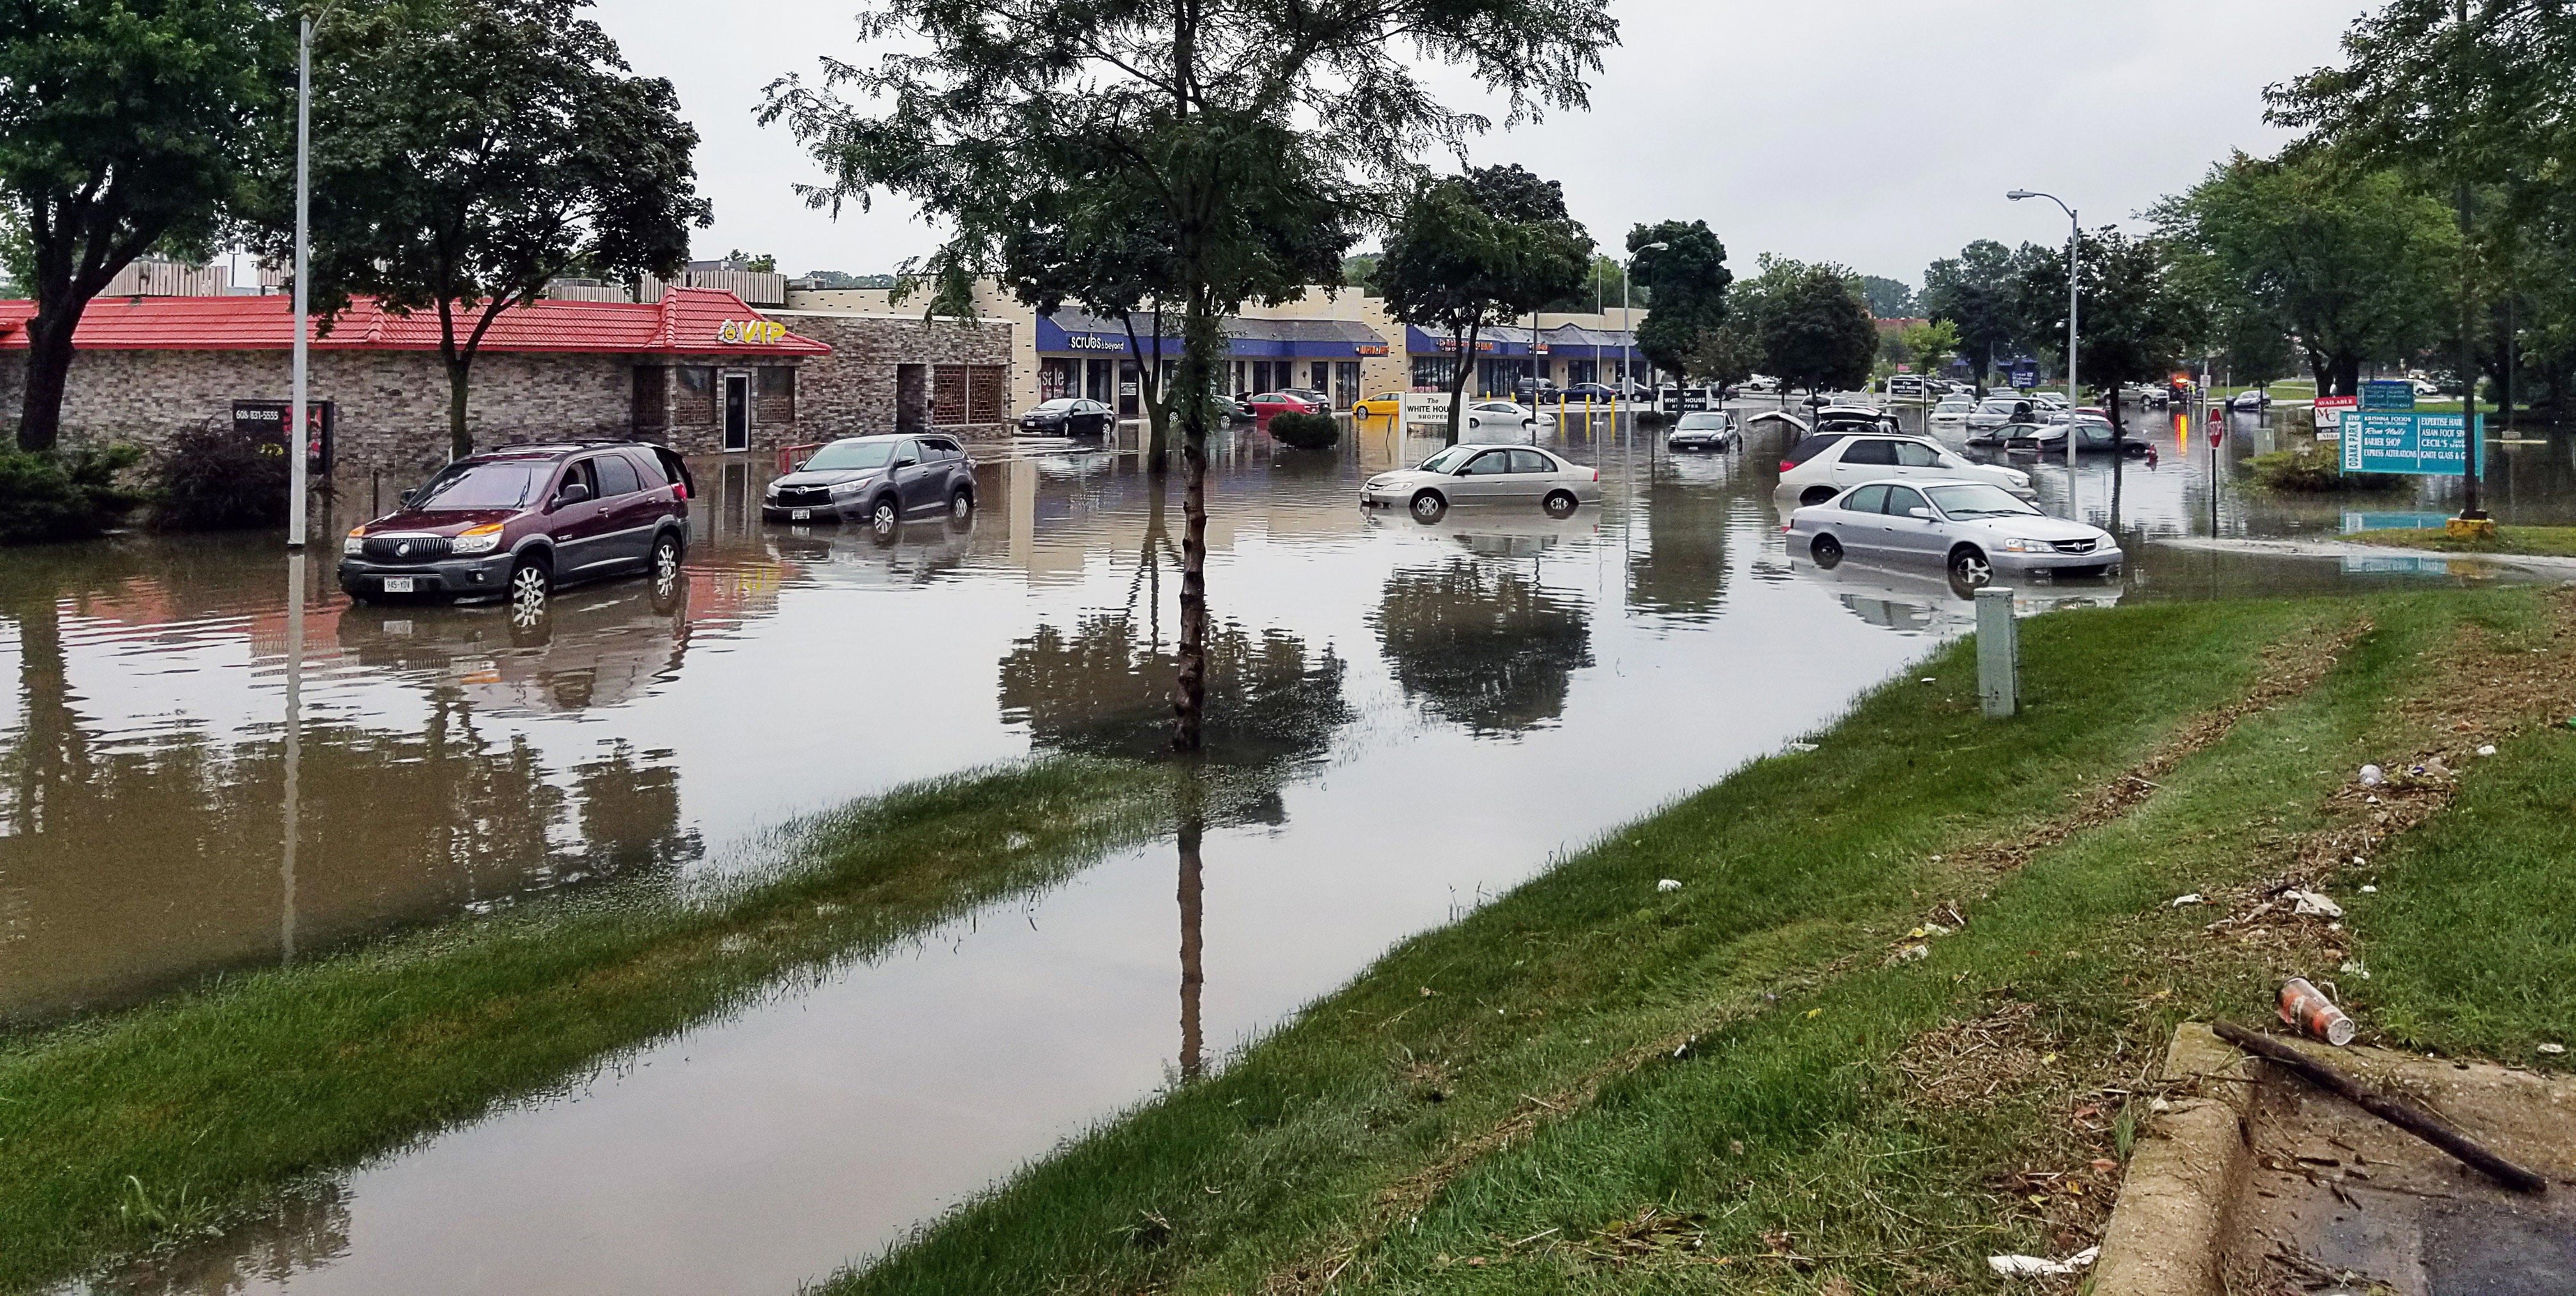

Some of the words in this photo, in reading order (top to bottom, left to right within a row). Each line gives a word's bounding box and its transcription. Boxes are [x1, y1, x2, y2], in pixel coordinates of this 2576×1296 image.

[738, 319, 786, 344] VIP
[1071, 332, 1101, 349] scrubs
[1105, 341, 1124, 351] beyond
[236, 410, 249, 419] 608
[250, 410, 279, 420] 831-5555
[2421, 417, 2448, 426] EXPERTISE
[2449, 418, 2462, 426] HAIR
[2209, 420, 2222, 436] STOP
[2348, 424, 2359, 442] PARK
[2421, 428, 2438, 436] ASIAN
[2439, 429, 2455, 437] FOOT
[2386, 438, 2401, 446] SHOP
[2421, 438, 2448, 447] CECIL'S
[2348, 444, 2359, 467] ODANA
[2421, 451, 2437, 459] IGNITE
[2438, 451, 2454, 459] GLASS
